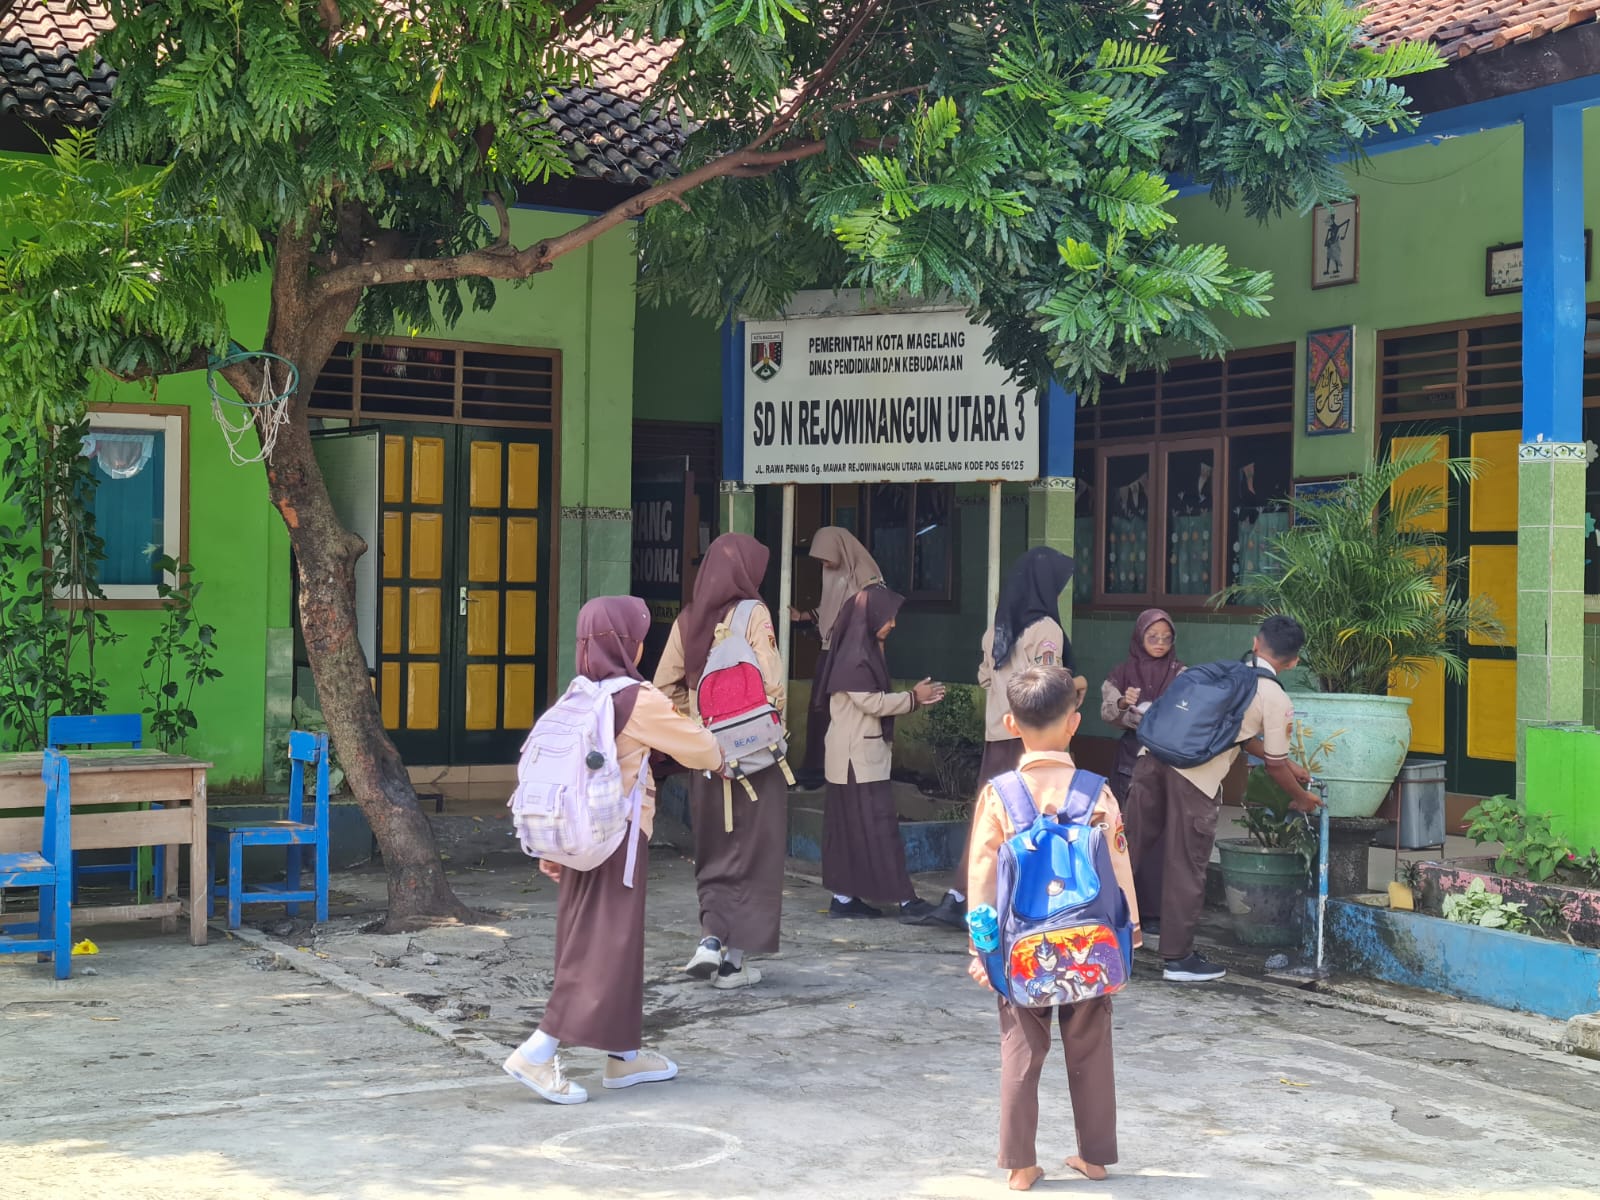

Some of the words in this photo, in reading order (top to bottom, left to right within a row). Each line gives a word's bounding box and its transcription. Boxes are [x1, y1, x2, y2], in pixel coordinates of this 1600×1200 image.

[808, 335, 873, 354] PEMERINTAH
[876, 334, 904, 351] KOTA
[906, 332, 965, 350] MAGELANG
[809, 359, 832, 376] DINAS
[834, 356, 880, 375] PENDIDIKAN
[882, 357, 901, 374] DAN
[902, 354, 963, 373] KEBUDAYAAN
[753, 401, 775, 447] SD
[781, 400, 793, 446] N
[798, 396, 942, 446] REJOWINANGUN
[948, 394, 1010, 442] UTARA
[1014, 393, 1025, 441] 3
[755, 464, 765, 474] JL.
[765, 464, 785, 474] RAWA
[785, 463, 809, 474] PENING
[811, 463, 822, 475] Gg.
[823, 462, 846, 473] MAWAR
[848, 462, 900, 473] REJOWINANGUN
[901, 462, 922, 471] UTARA
[924, 461, 962, 471] MAGELANG
[964, 461, 984, 470] KODE
[985, 461, 999, 470] POS
[1001, 460, 1024, 470] 56125
